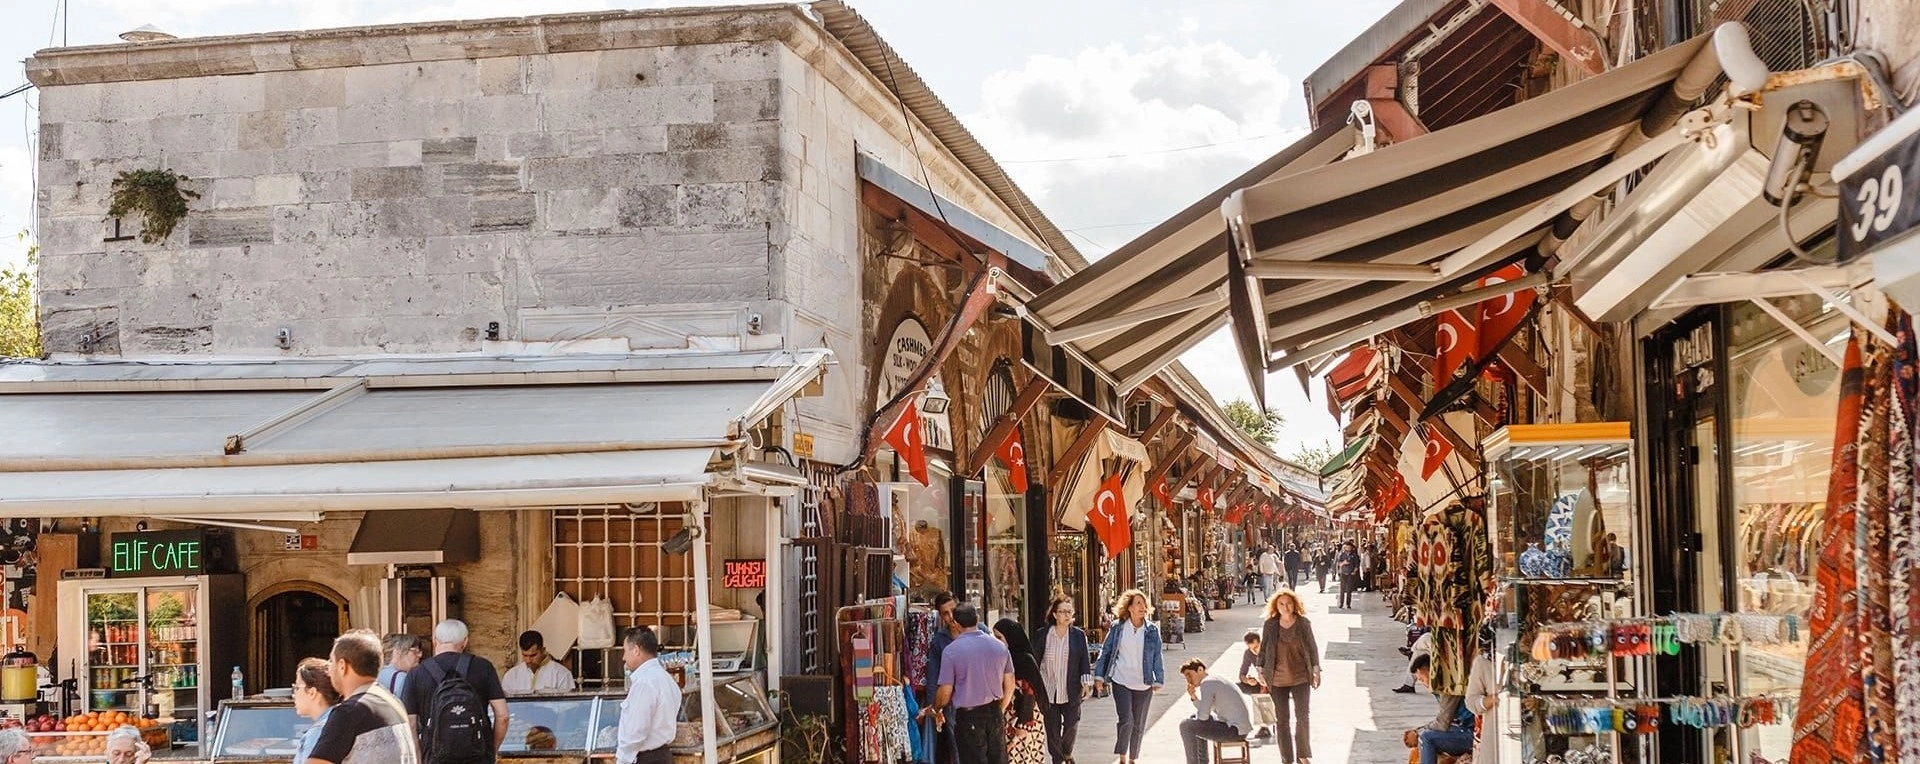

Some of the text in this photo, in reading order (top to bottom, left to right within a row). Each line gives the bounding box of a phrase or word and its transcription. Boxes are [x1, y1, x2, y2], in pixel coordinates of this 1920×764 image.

[1851, 164, 1903, 242] 39
[897, 337, 927, 357] CASHMER
[151, 541, 199, 570] CAFE
[724, 574, 766, 588] DELIGHT
